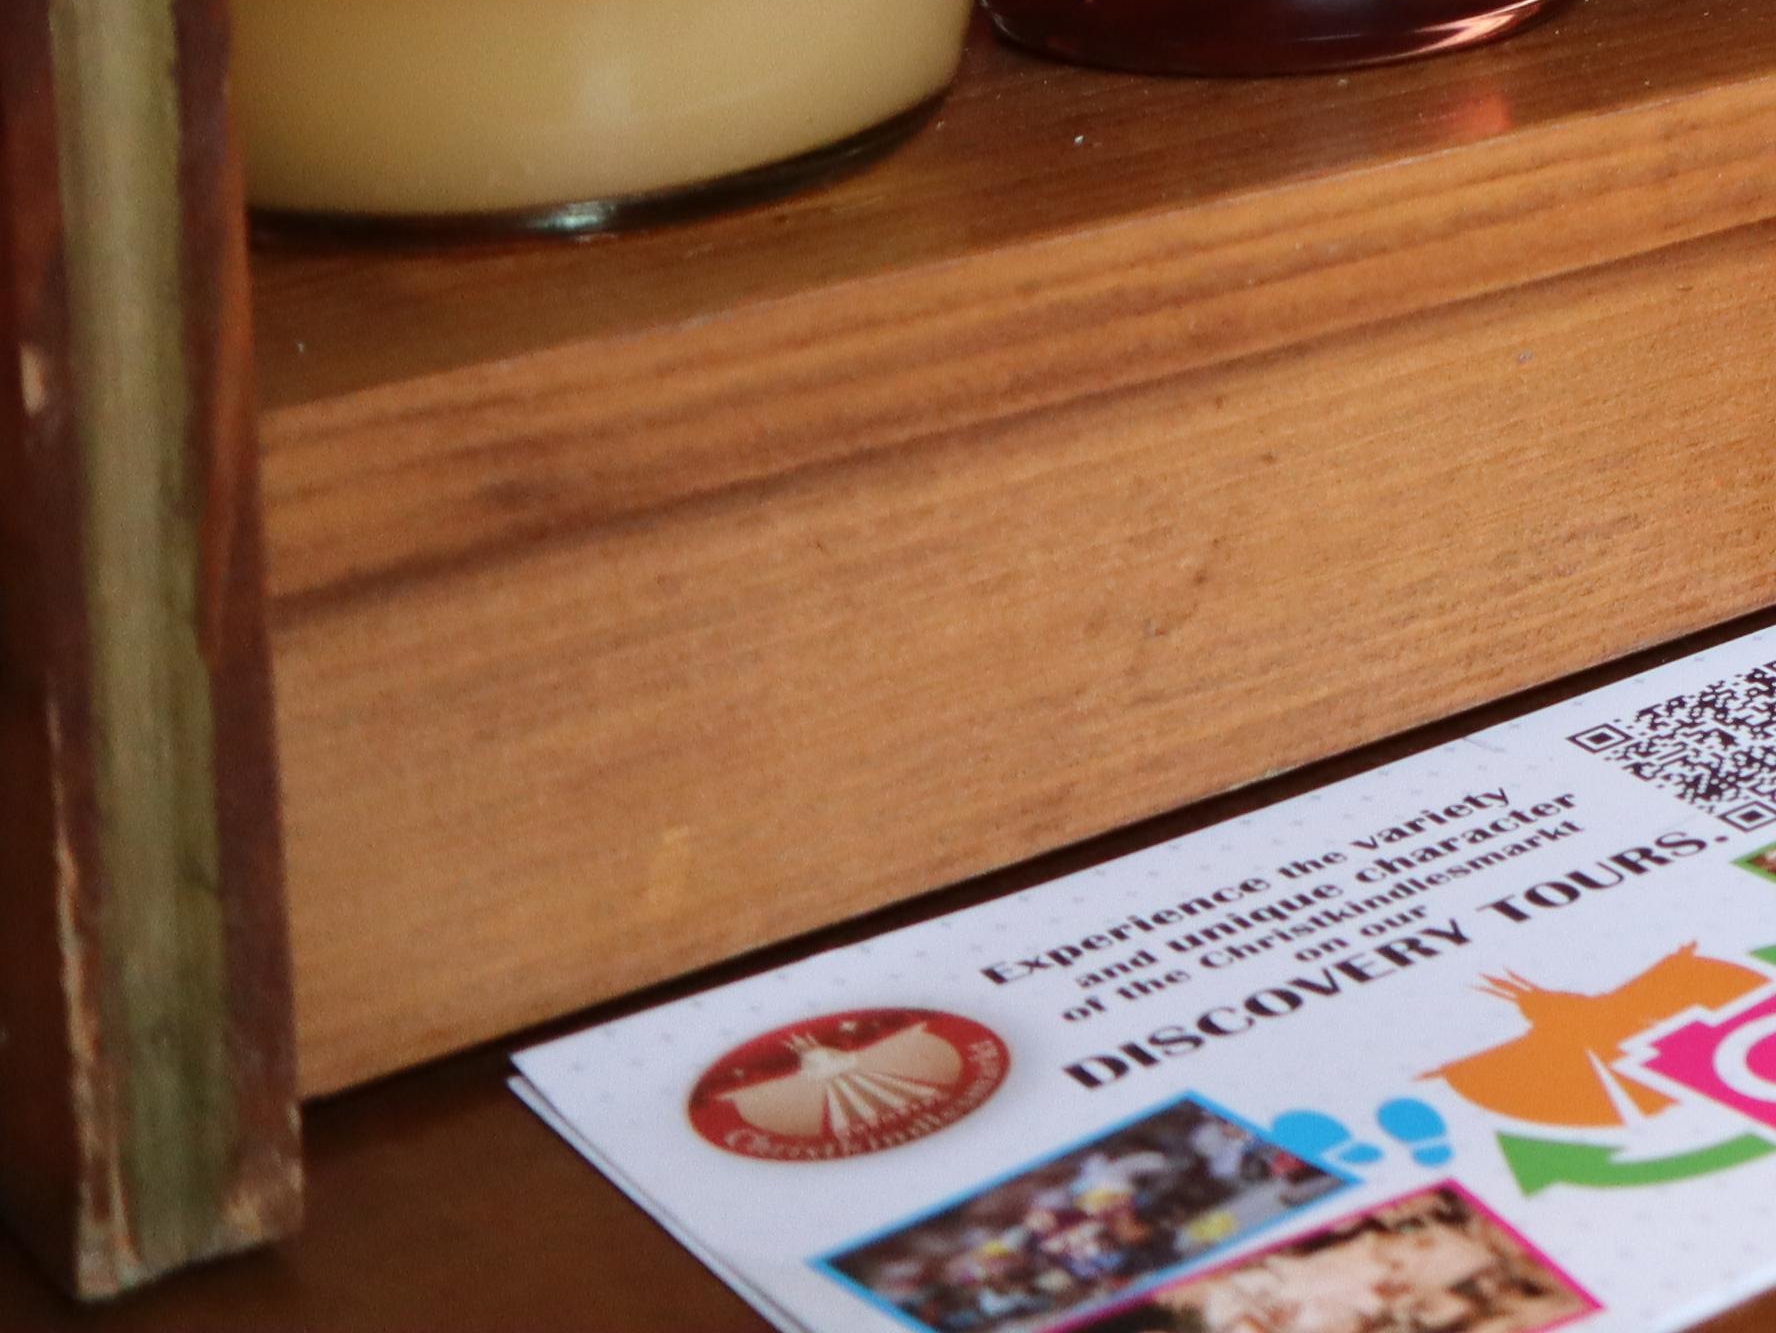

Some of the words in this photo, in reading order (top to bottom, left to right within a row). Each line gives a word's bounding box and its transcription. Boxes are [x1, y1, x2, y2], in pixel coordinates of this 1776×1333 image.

[980, 878, 1271, 985] Experience
[1278, 850, 1347, 879] the
[1350, 787, 1511, 850] variety
[1062, 995, 1107, 1023] of
[1116, 969, 1191, 1001] the
[1199, 819, 1585, 969] Christkindlesmarkt
[1062, 918, 1473, 1088] DISCOVERY
[1476, 830, 1729, 923] TOURS.
[1075, 948, 1159, 988] and
[1167, 884, 1344, 952] unique
[1355, 793, 1577, 884] character
[1295, 937, 1349, 962] on
[1360, 904, 1428, 938] our
